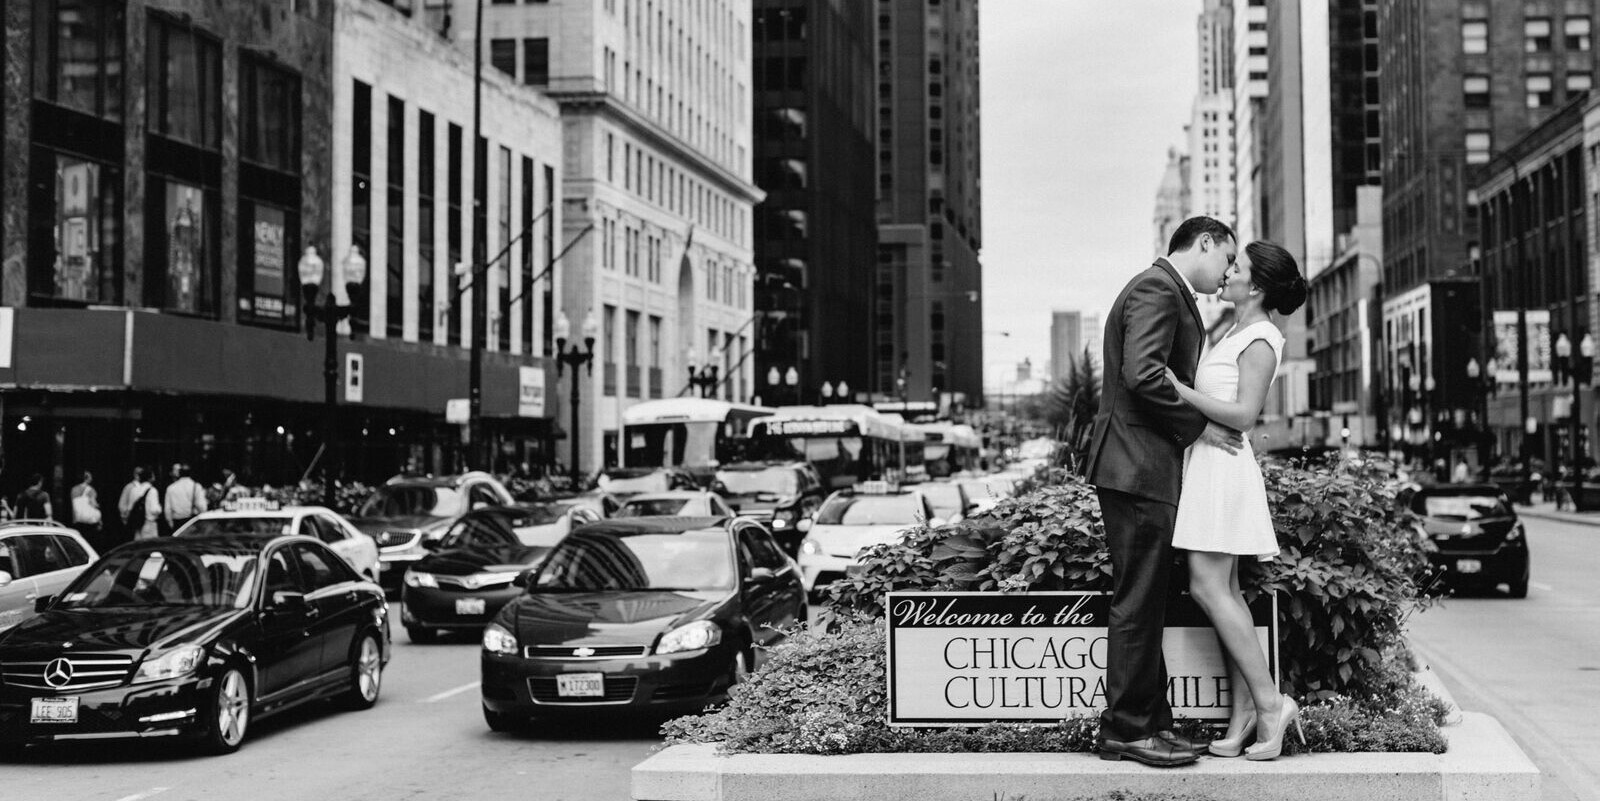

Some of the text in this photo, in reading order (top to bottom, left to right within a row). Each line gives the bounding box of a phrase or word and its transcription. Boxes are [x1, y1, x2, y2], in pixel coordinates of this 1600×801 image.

[893, 595, 1095, 626] Welcome to the
[944, 676, 1110, 709] CULTURA
